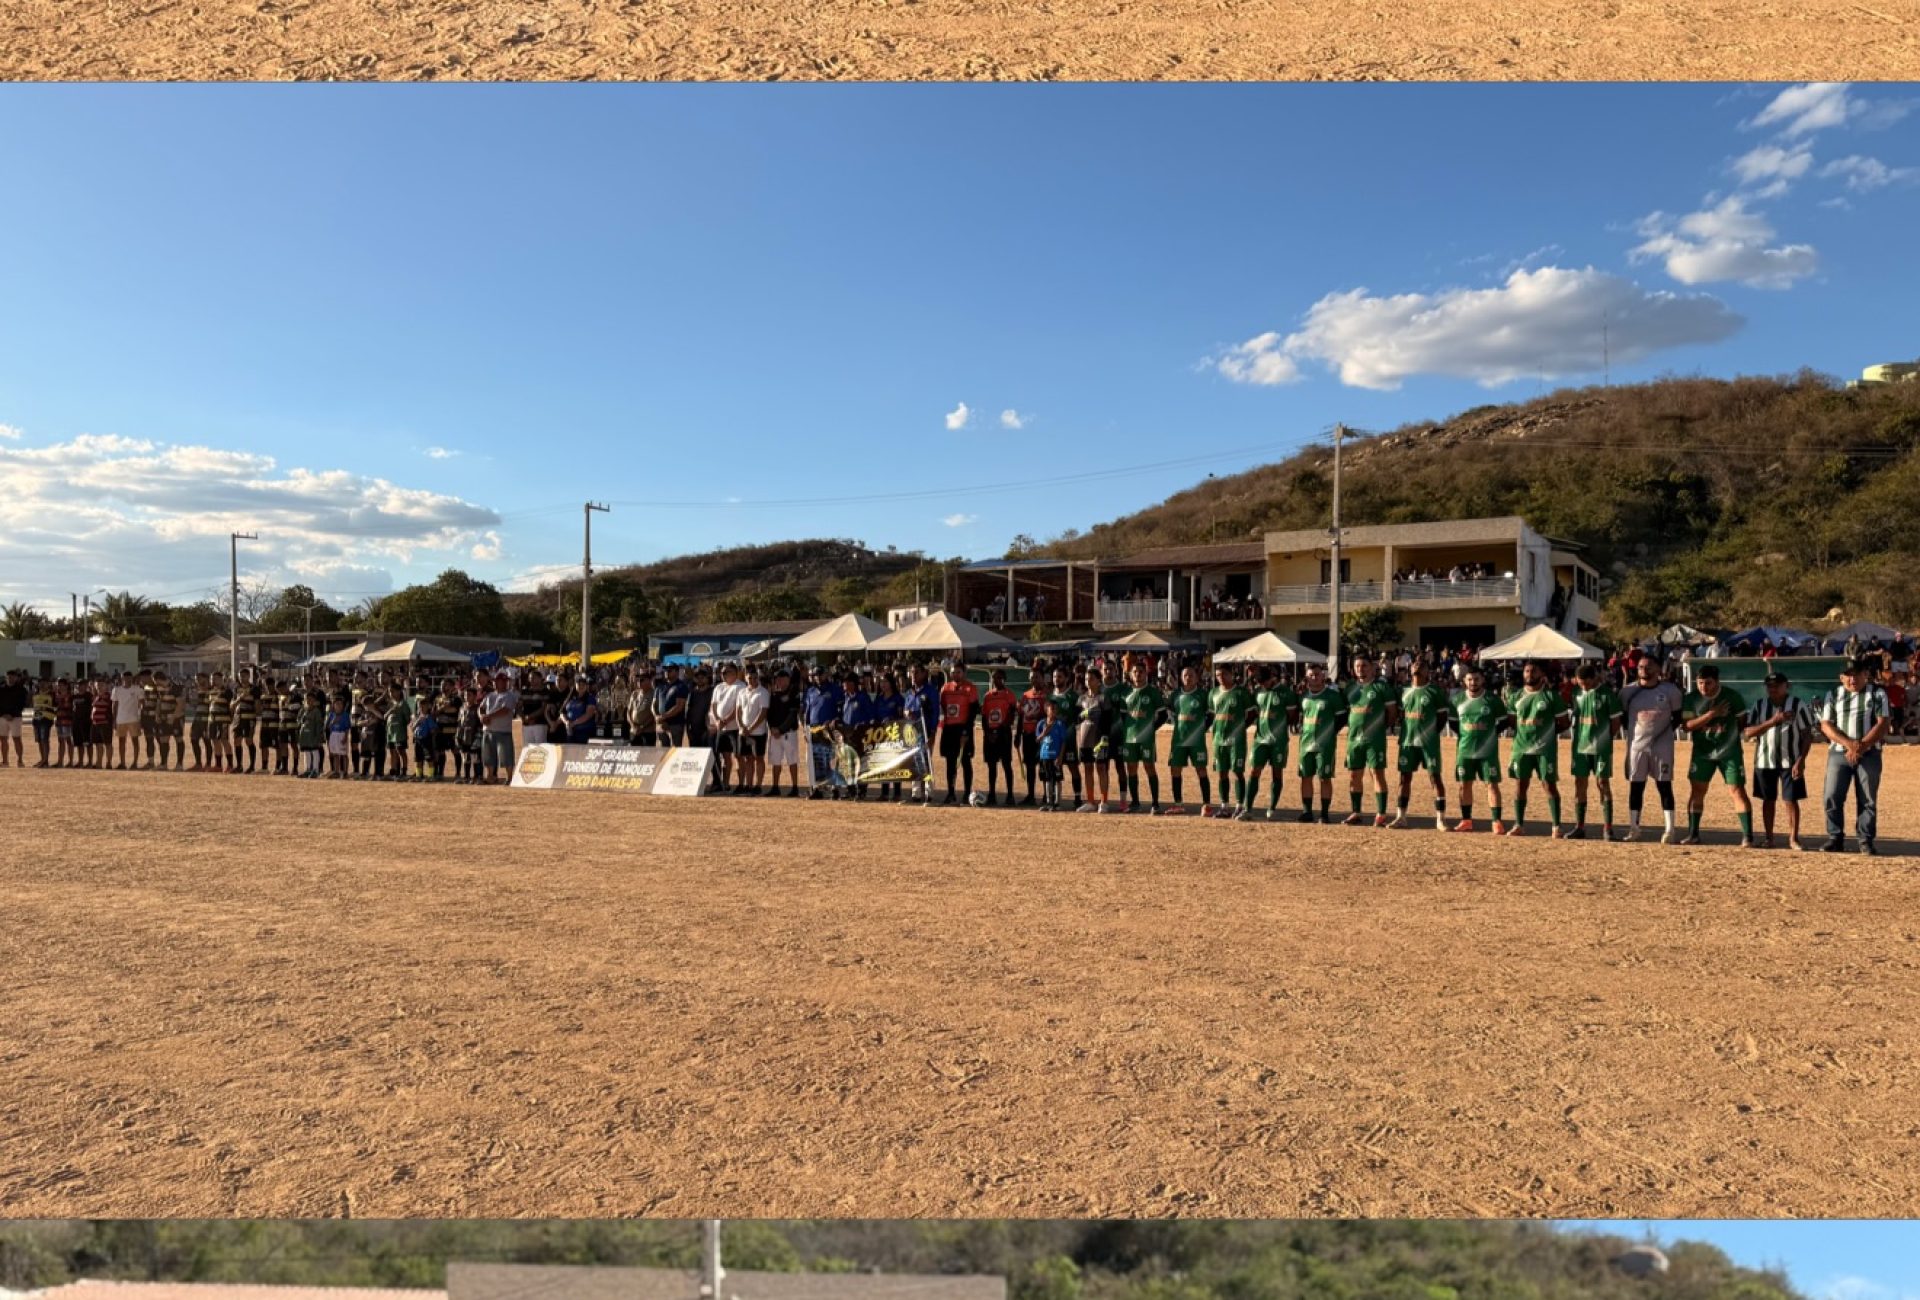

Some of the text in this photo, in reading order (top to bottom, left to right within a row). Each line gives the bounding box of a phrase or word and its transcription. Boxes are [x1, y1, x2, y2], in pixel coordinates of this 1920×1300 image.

[863, 722, 900, 744] JOSÉ
[603, 749, 640, 762] GRANDE
[562, 761, 656, 776] TORNEIO DE TANQUES
[566, 774, 642, 789] POÇO DANTAS-PB
